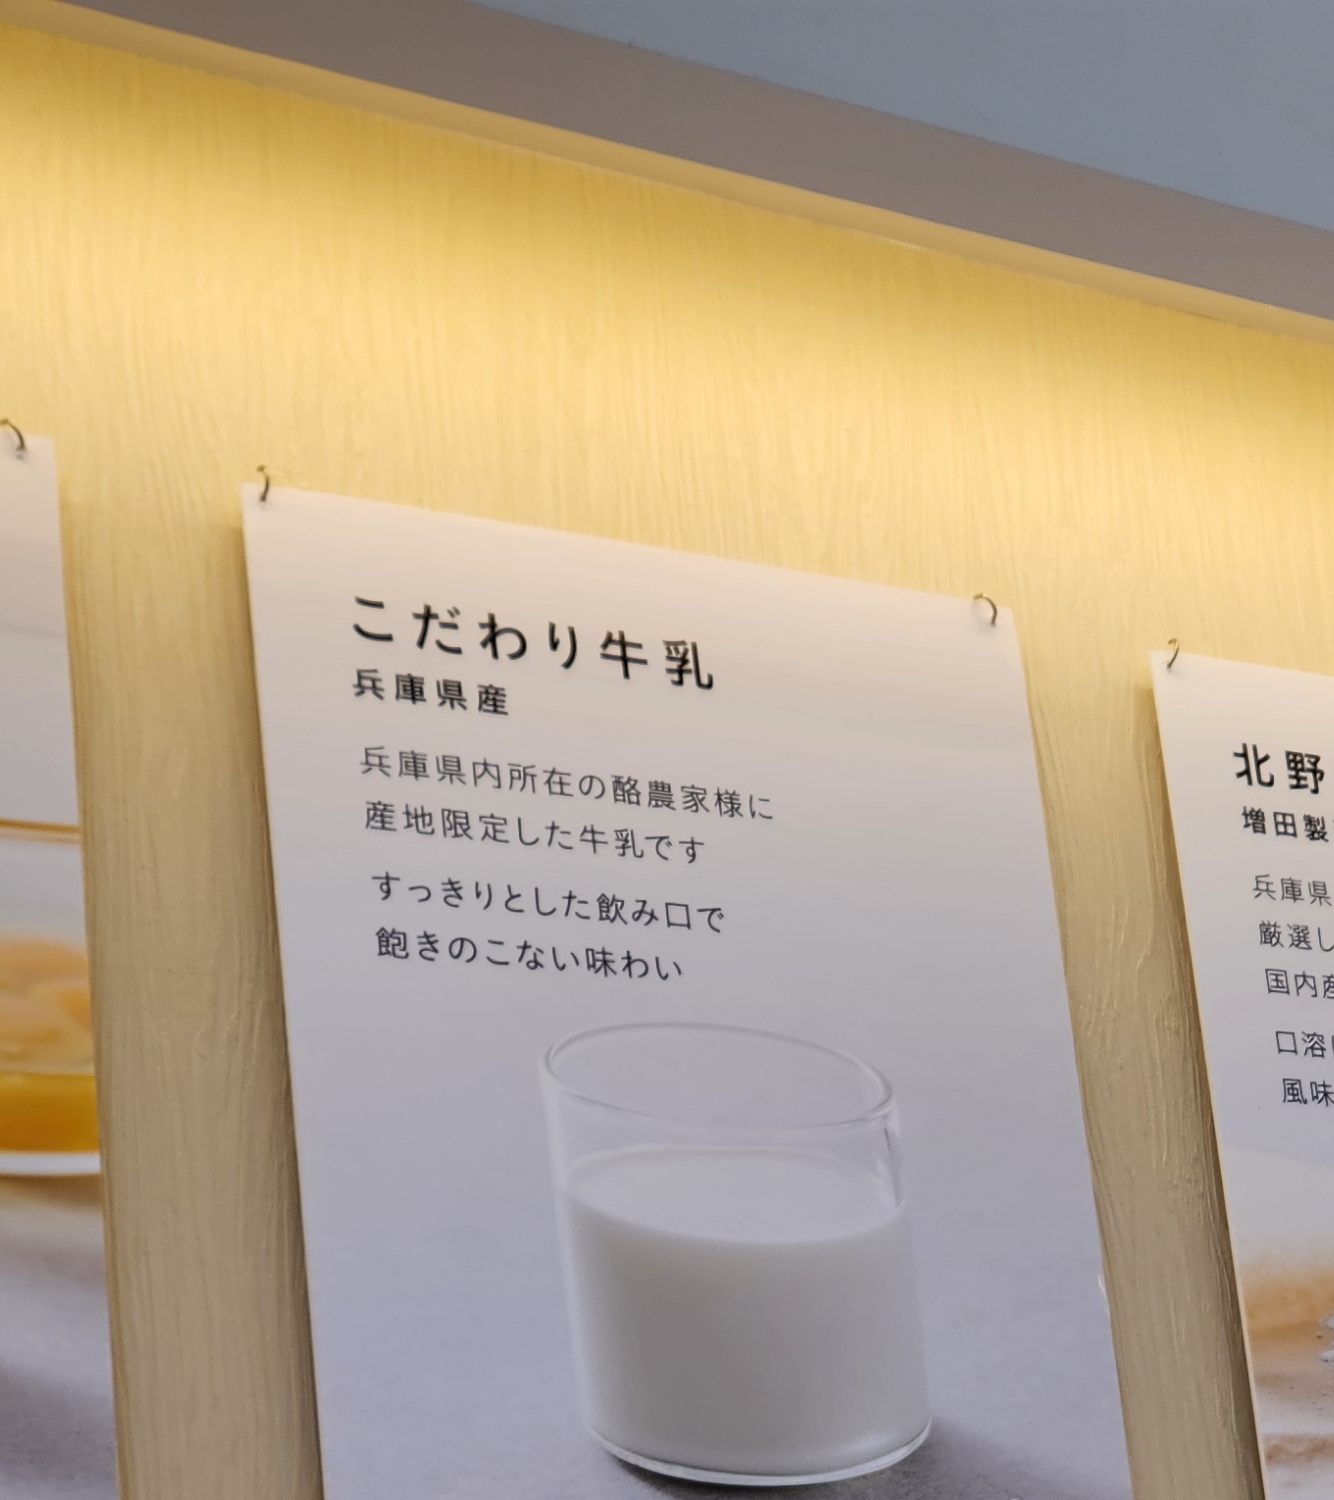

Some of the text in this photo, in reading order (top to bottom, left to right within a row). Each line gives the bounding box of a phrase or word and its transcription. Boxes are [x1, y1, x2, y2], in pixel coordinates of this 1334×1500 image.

[353, 595, 713, 688] こだわり牛乳
[353, 669, 507, 715] 兵庫県産
[359, 747, 773, 819] 兵庫県内所在の酪農家様に
[365, 801, 704, 862] 産地限定した牛乳です
[372, 871, 724, 931] すっきりとした飲み口で
[376, 926, 681, 978] 飽きのこない味わい
